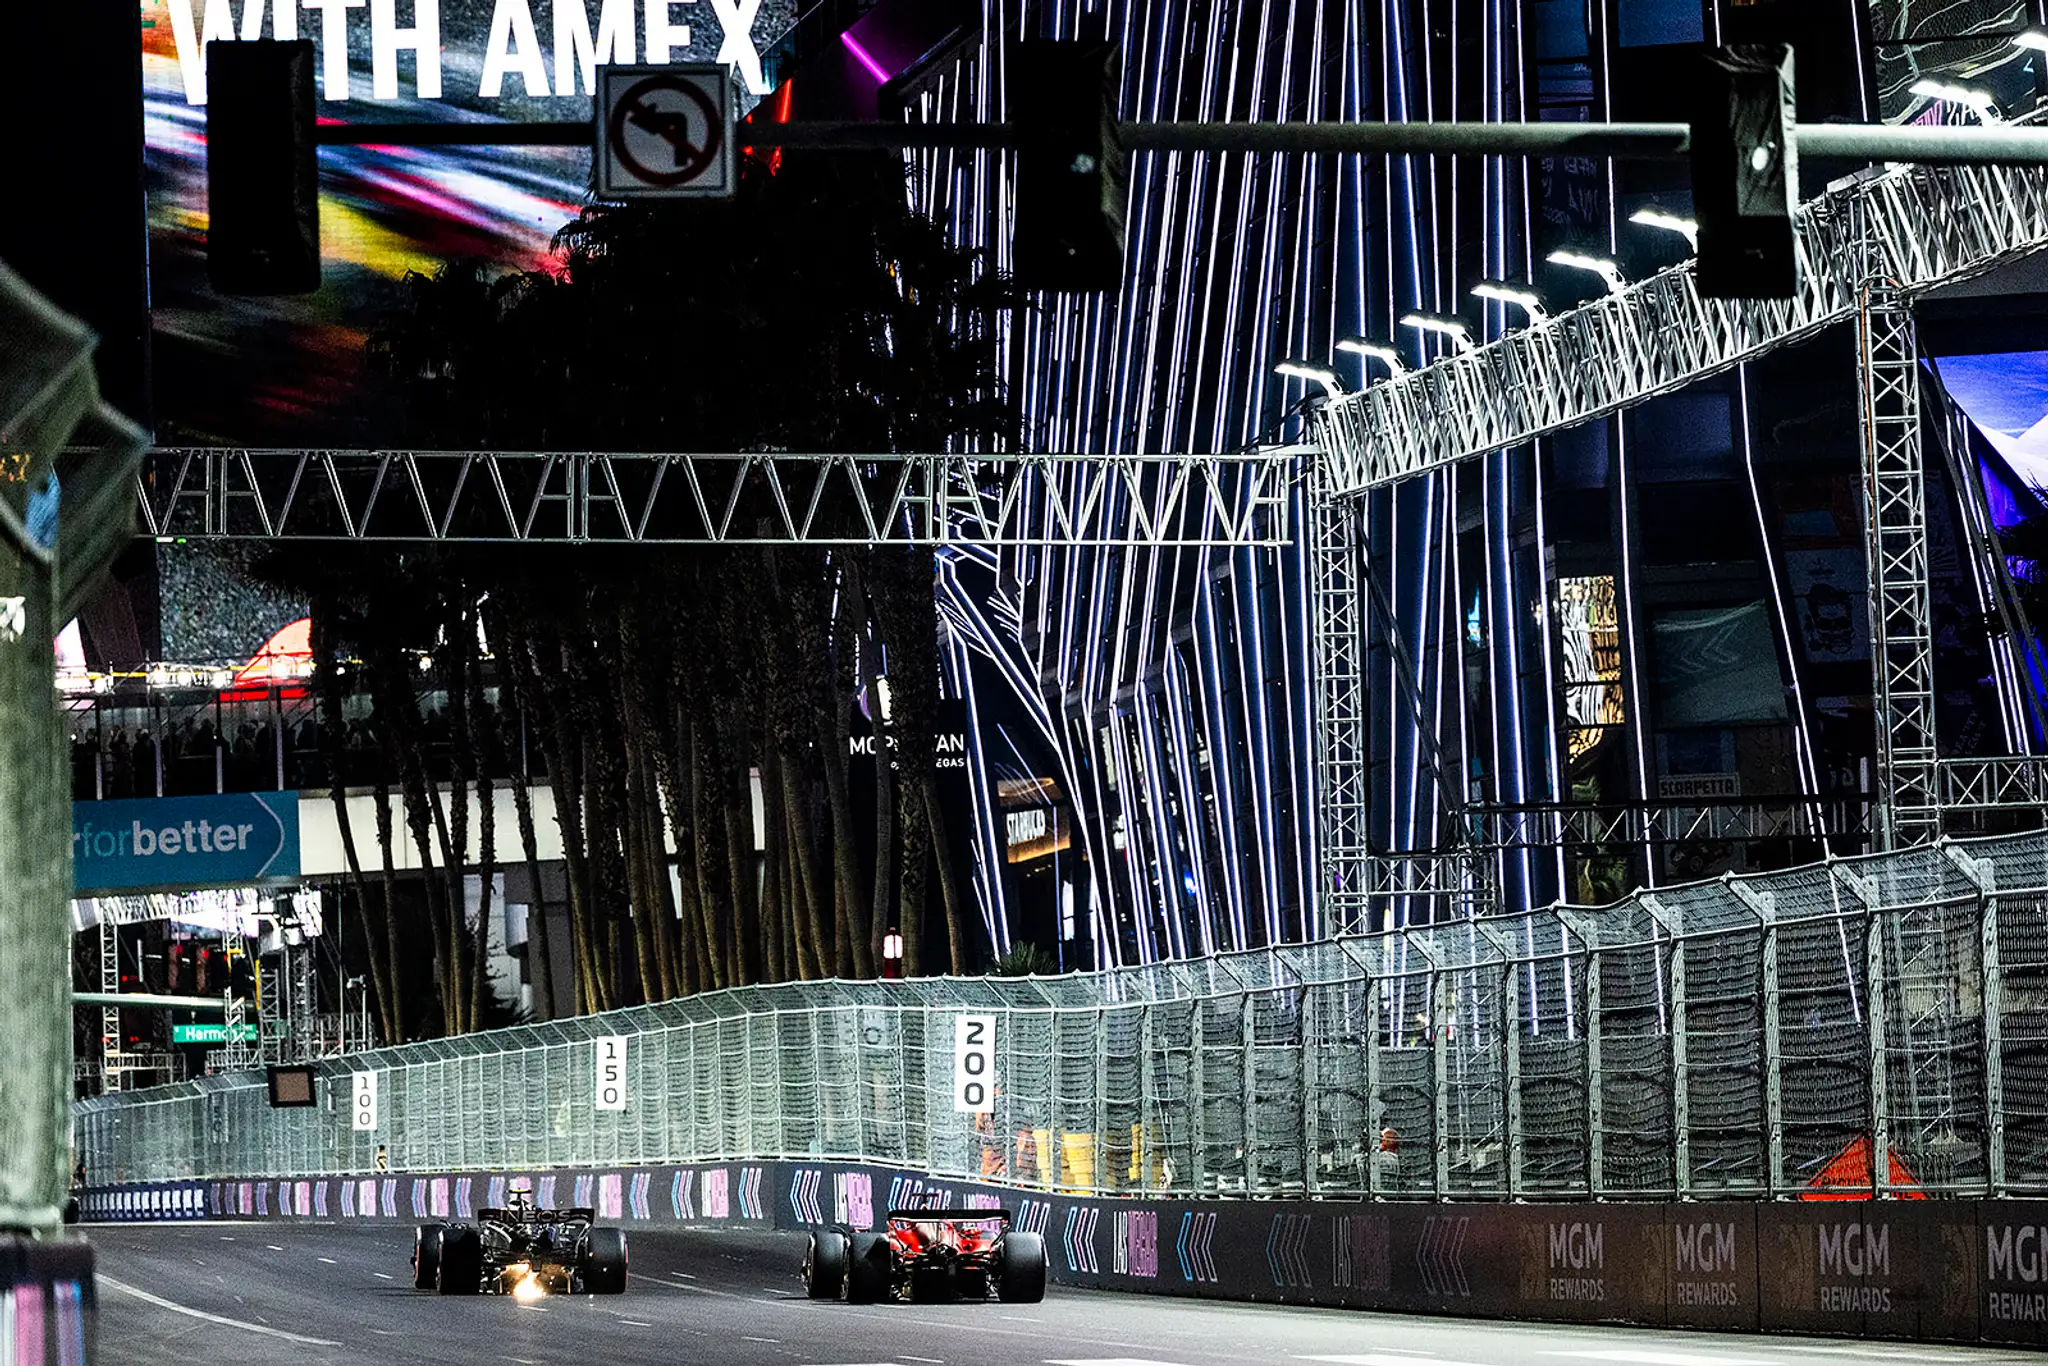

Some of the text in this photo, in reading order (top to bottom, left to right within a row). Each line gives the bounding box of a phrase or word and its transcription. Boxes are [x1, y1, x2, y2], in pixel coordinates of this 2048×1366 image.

[1660, 778, 1733, 797] SCARPETTA
[603, 1042, 618, 1104] 150
[964, 1021, 985, 1106] 200
[359, 1076, 372, 1126] 100
[500, 1210, 569, 1224] INEOS
[1113, 1211, 1128, 1275] LAS
[1549, 1222, 1604, 1269] MGM
[1675, 1222, 1735, 1272] MGM
[1819, 1223, 1889, 1276] MGM
[1550, 1278, 1606, 1301] REWARDS
[1677, 1282, 1739, 1305] REWARDS
[1820, 1286, 1891, 1312] REWARDS
[1989, 1292, 2048, 1321] REWAR
